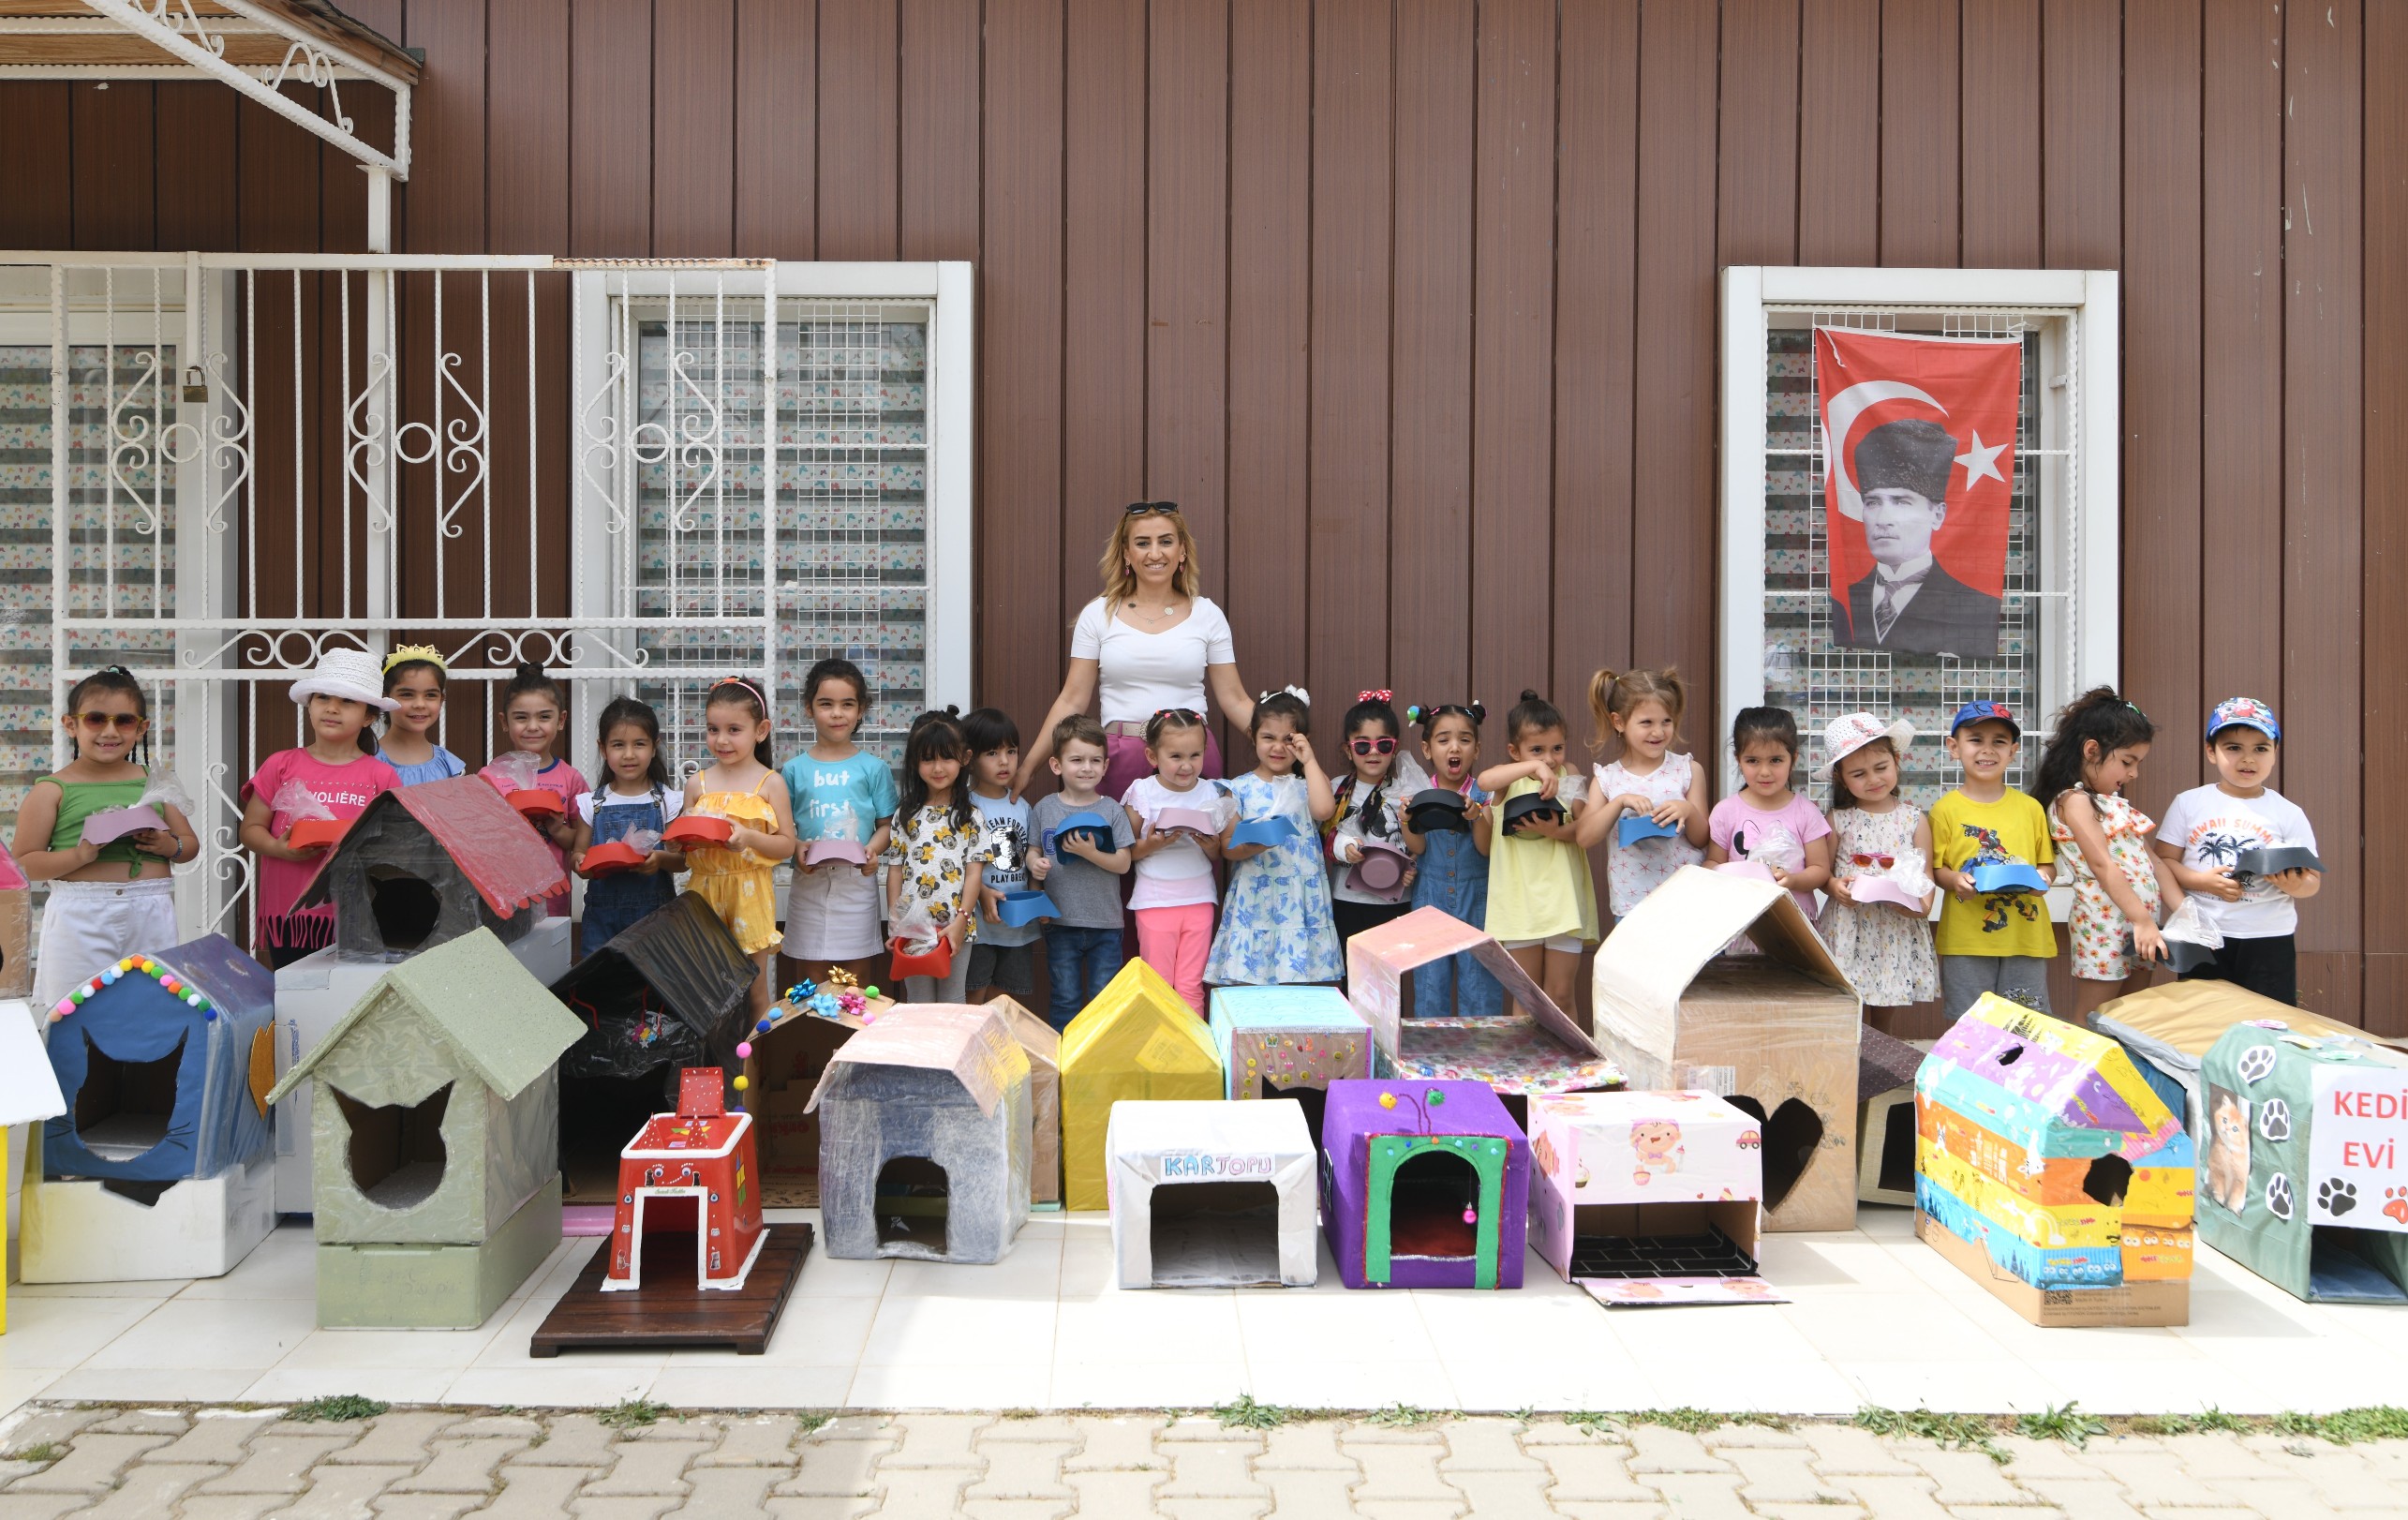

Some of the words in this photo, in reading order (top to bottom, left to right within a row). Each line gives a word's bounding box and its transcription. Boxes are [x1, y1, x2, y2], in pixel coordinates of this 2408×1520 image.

[813, 769, 850, 788] but
[810, 798, 850, 819] first
[2188, 818, 2226, 845] HAWAII
[991, 874, 1009, 884] PLAY
[2334, 1088, 2408, 1120] KEDİ
[2343, 1138, 2394, 1170] EVİ
[1165, 1155, 1271, 1176] KARTOPU
